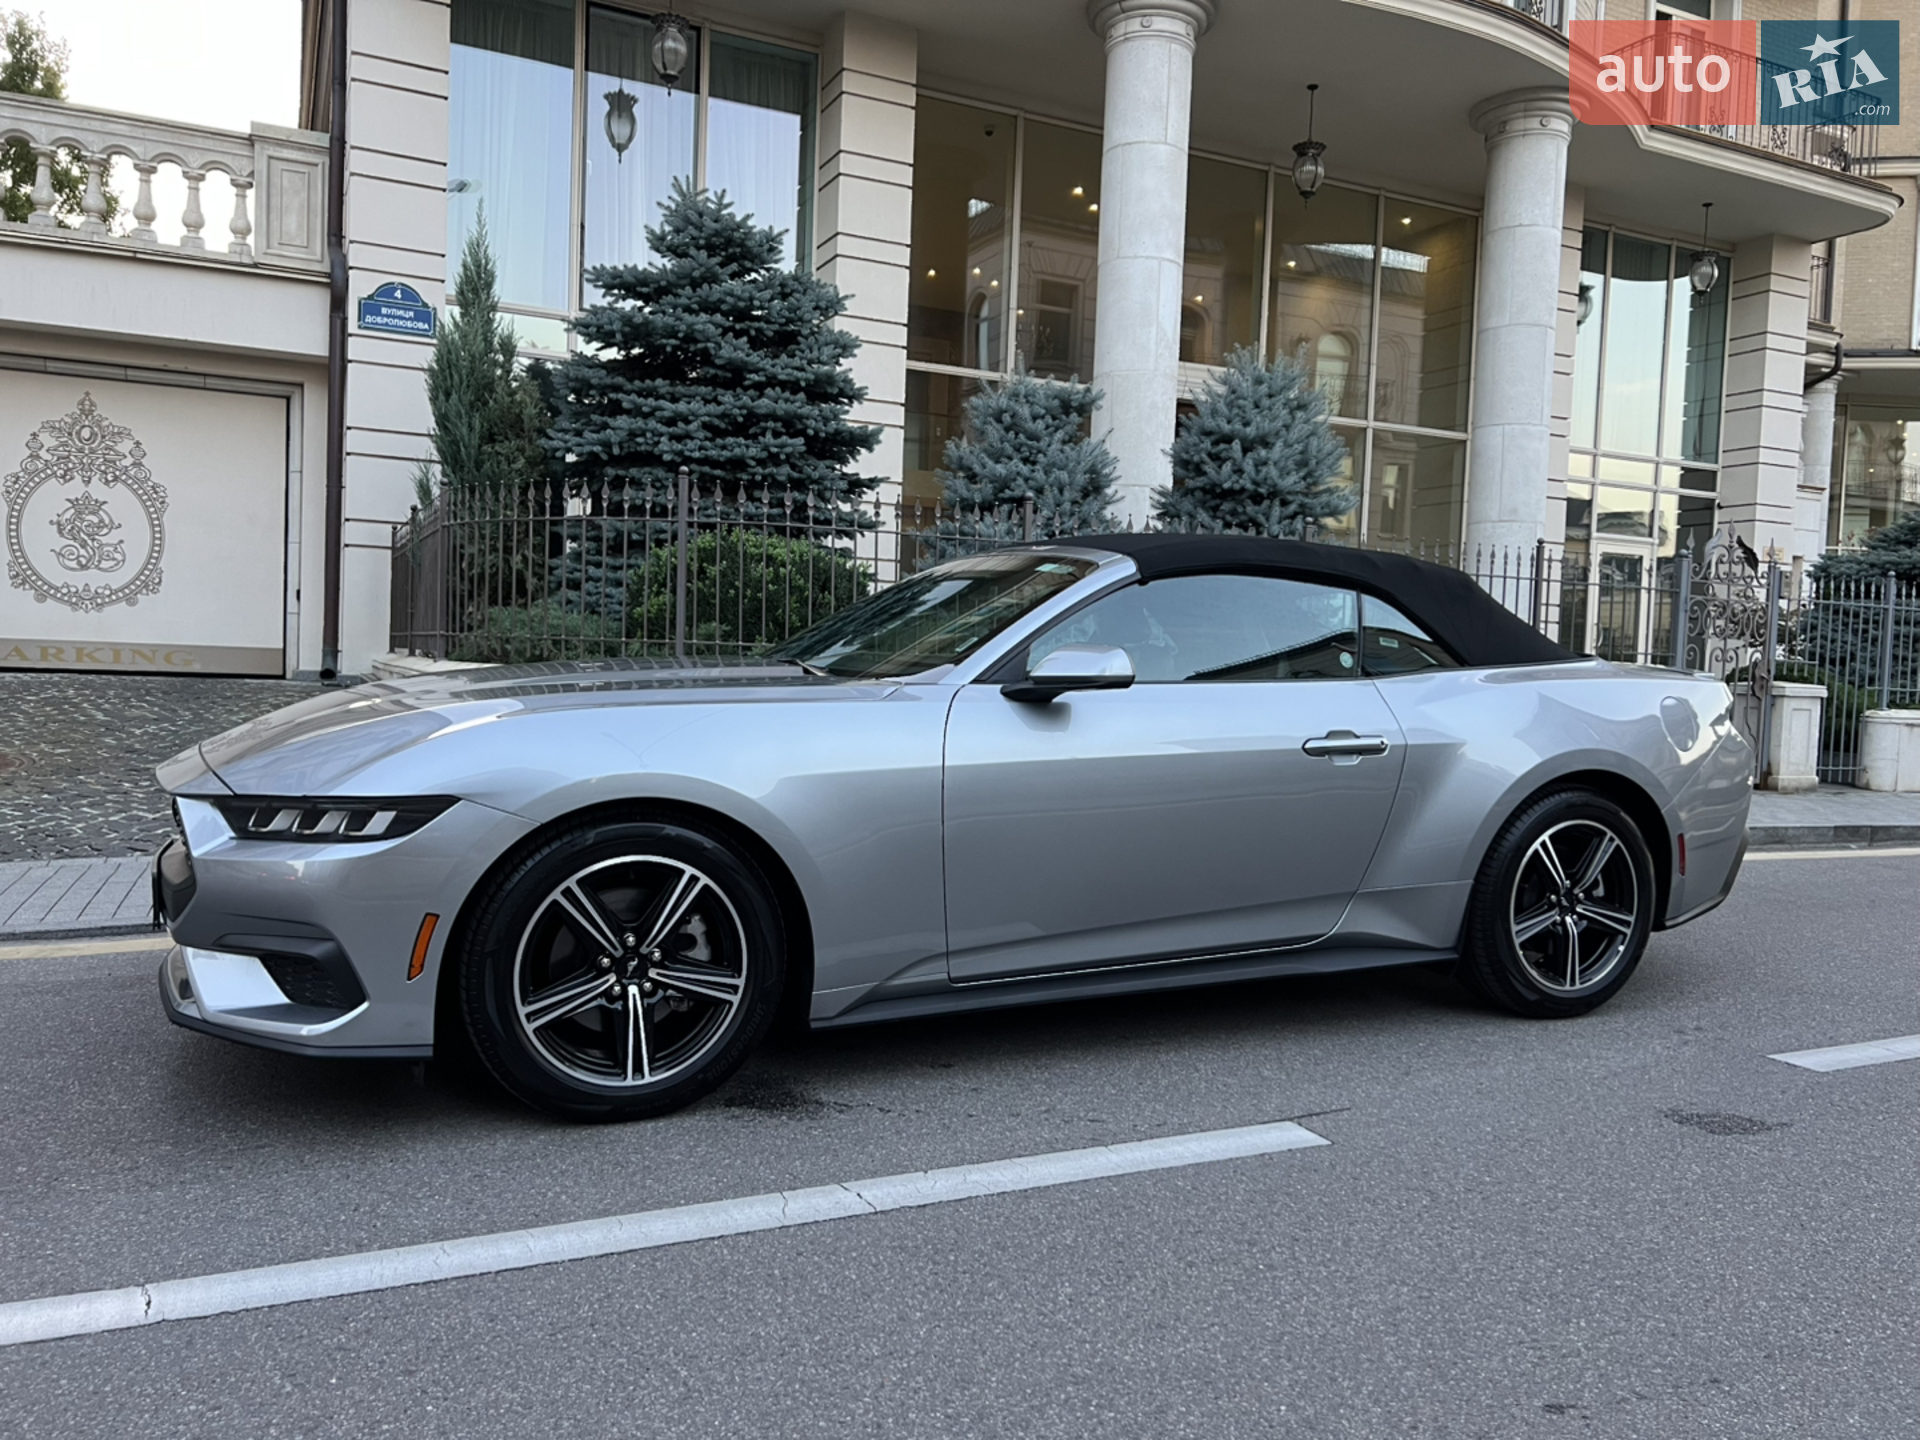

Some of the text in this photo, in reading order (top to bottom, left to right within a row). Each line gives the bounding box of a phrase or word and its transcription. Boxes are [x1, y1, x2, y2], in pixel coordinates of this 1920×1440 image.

[394, 288, 402, 299] 4
[381, 307, 414, 318] ВУЛИЦЯ
[365, 315, 429, 330] ДОБРОЛЮБОВА
